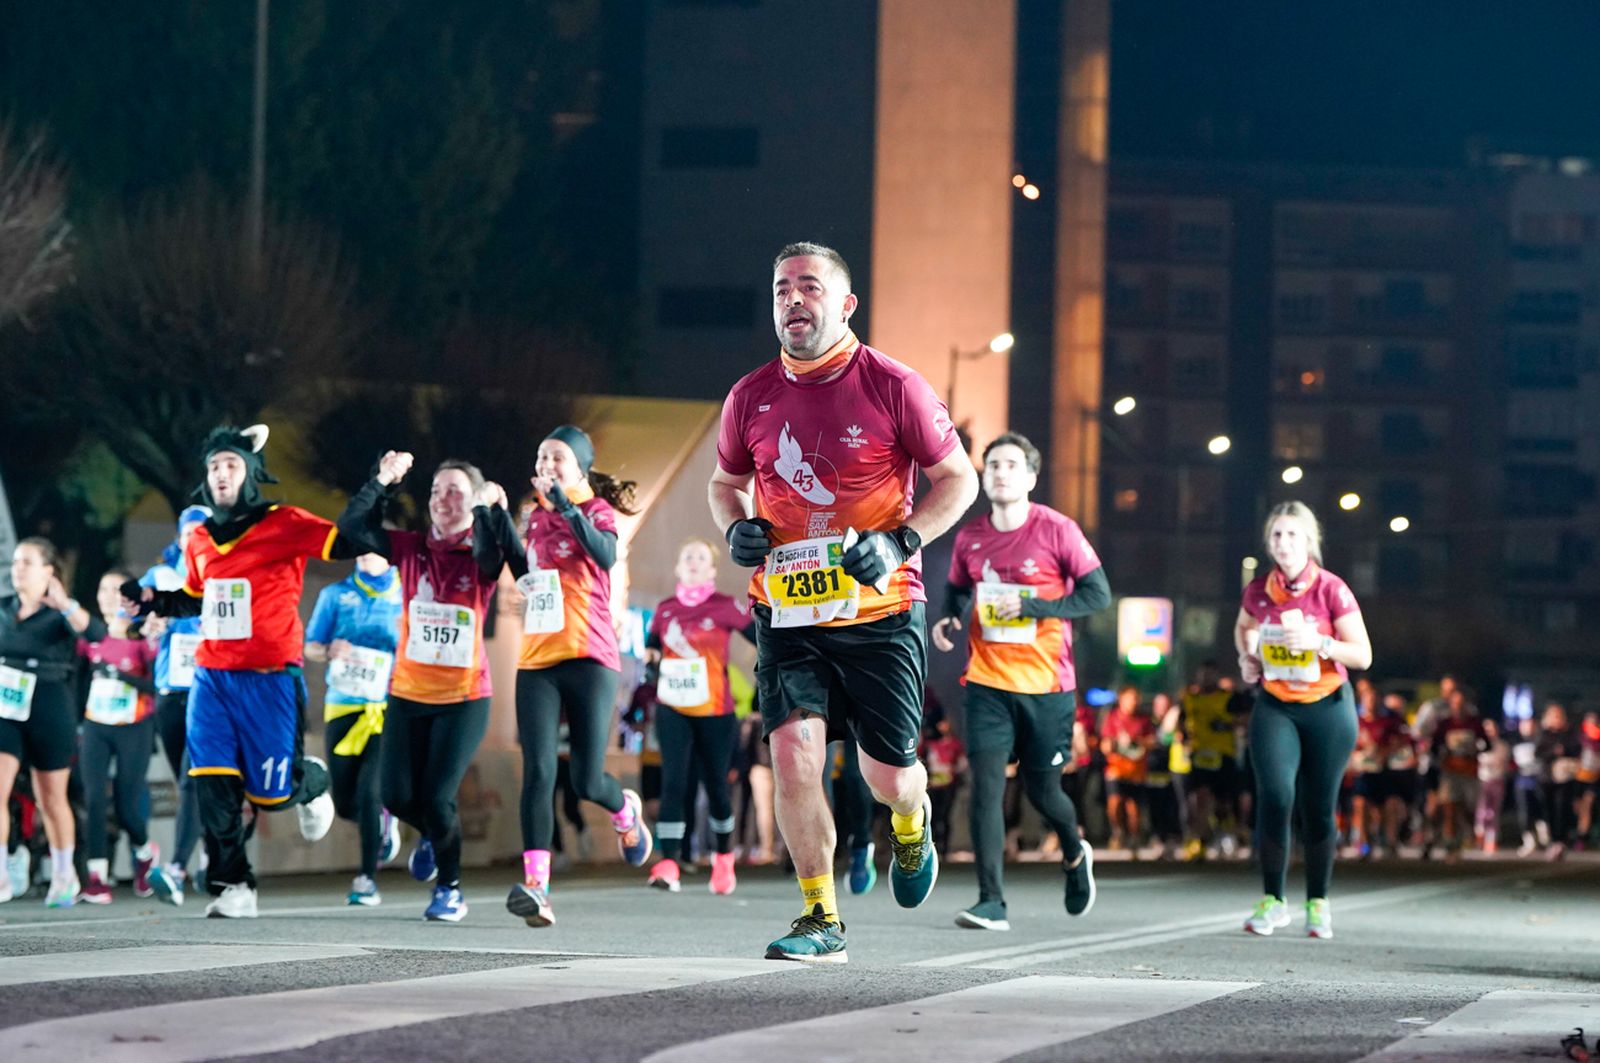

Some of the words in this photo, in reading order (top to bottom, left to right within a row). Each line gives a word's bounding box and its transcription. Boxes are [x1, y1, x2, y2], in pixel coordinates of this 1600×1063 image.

[792, 469, 814, 492] 43
[808, 522, 827, 530] SAN
[784, 549, 807, 562] NOCHE
[808, 548, 819, 558] DE
[781, 568, 840, 598] 2381
[423, 625, 459, 645] 5157
[261, 756, 289, 790] 11
